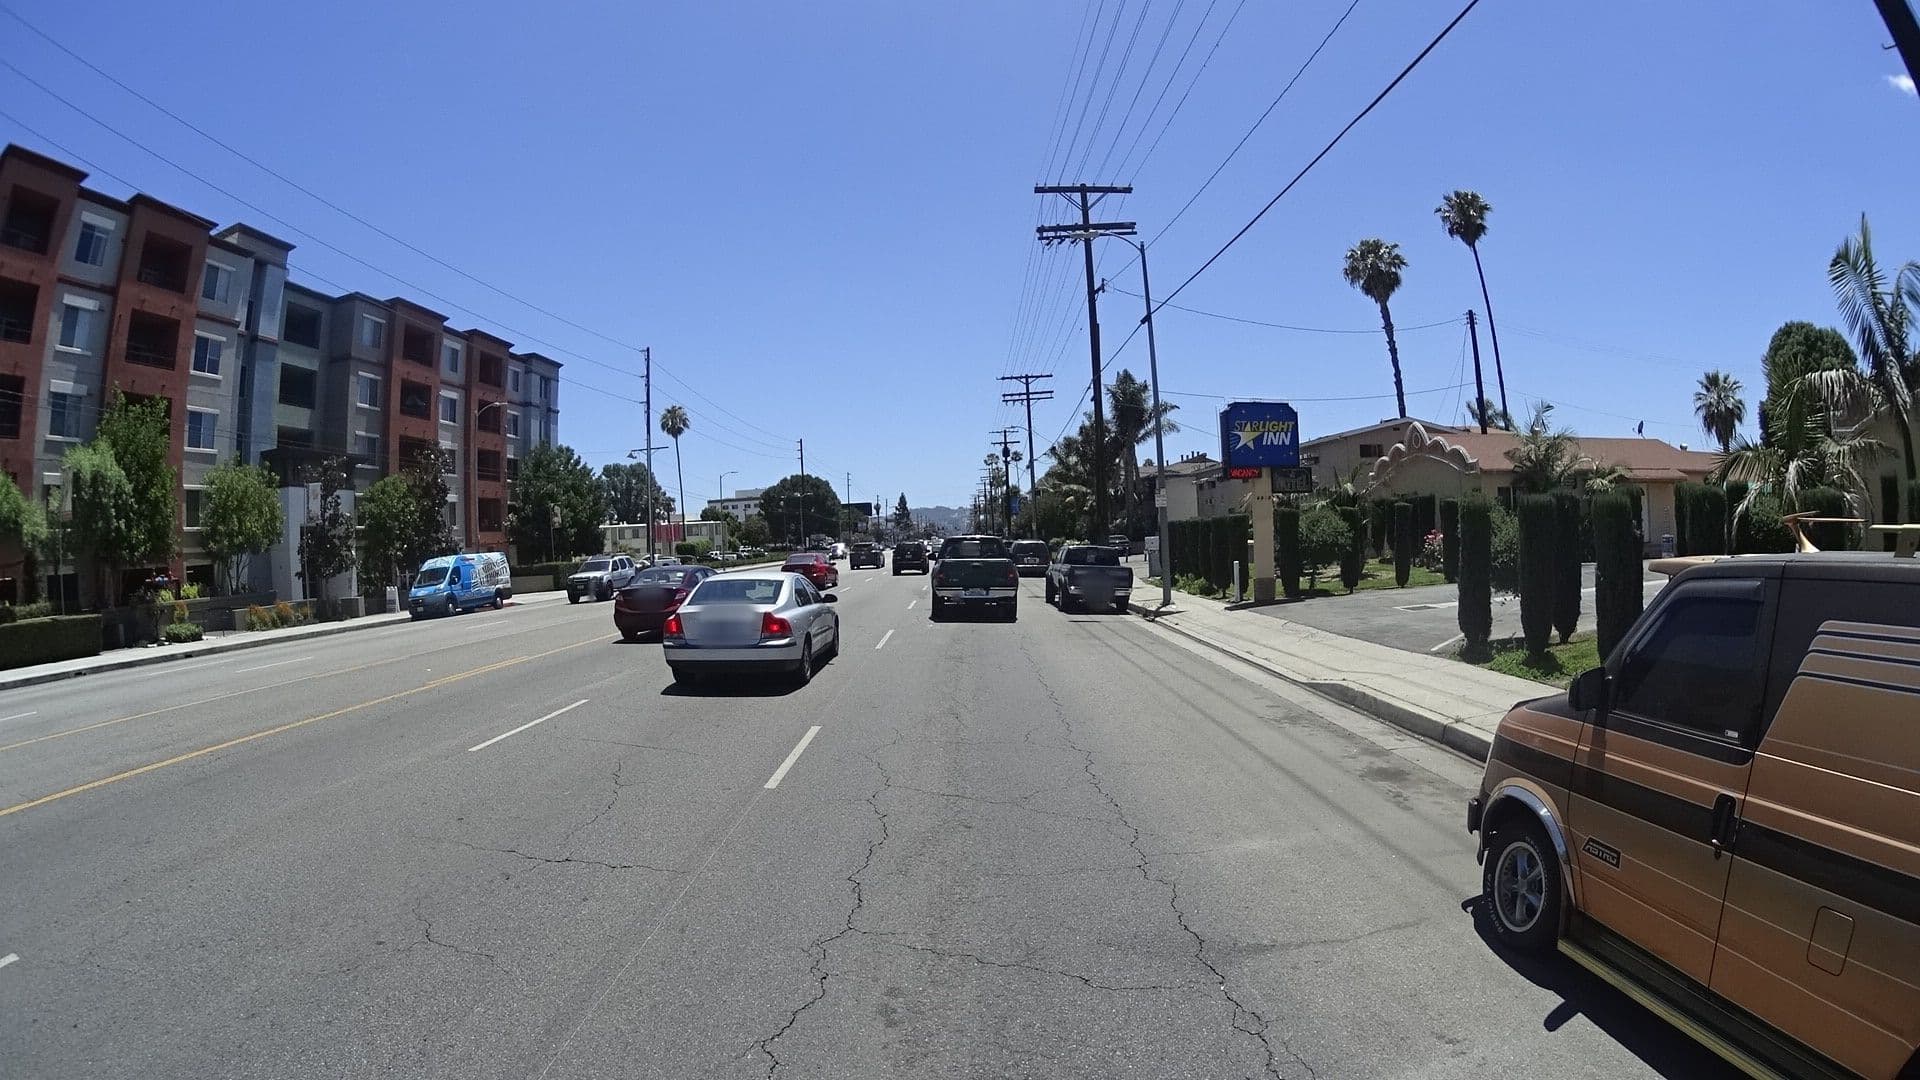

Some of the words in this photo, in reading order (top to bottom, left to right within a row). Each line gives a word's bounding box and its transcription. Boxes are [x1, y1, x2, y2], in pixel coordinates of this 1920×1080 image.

[1234, 420, 1295, 432] STARLIGHT
[1262, 432, 1291, 445] INN
[1585, 843, 1617, 864] ASTRO
